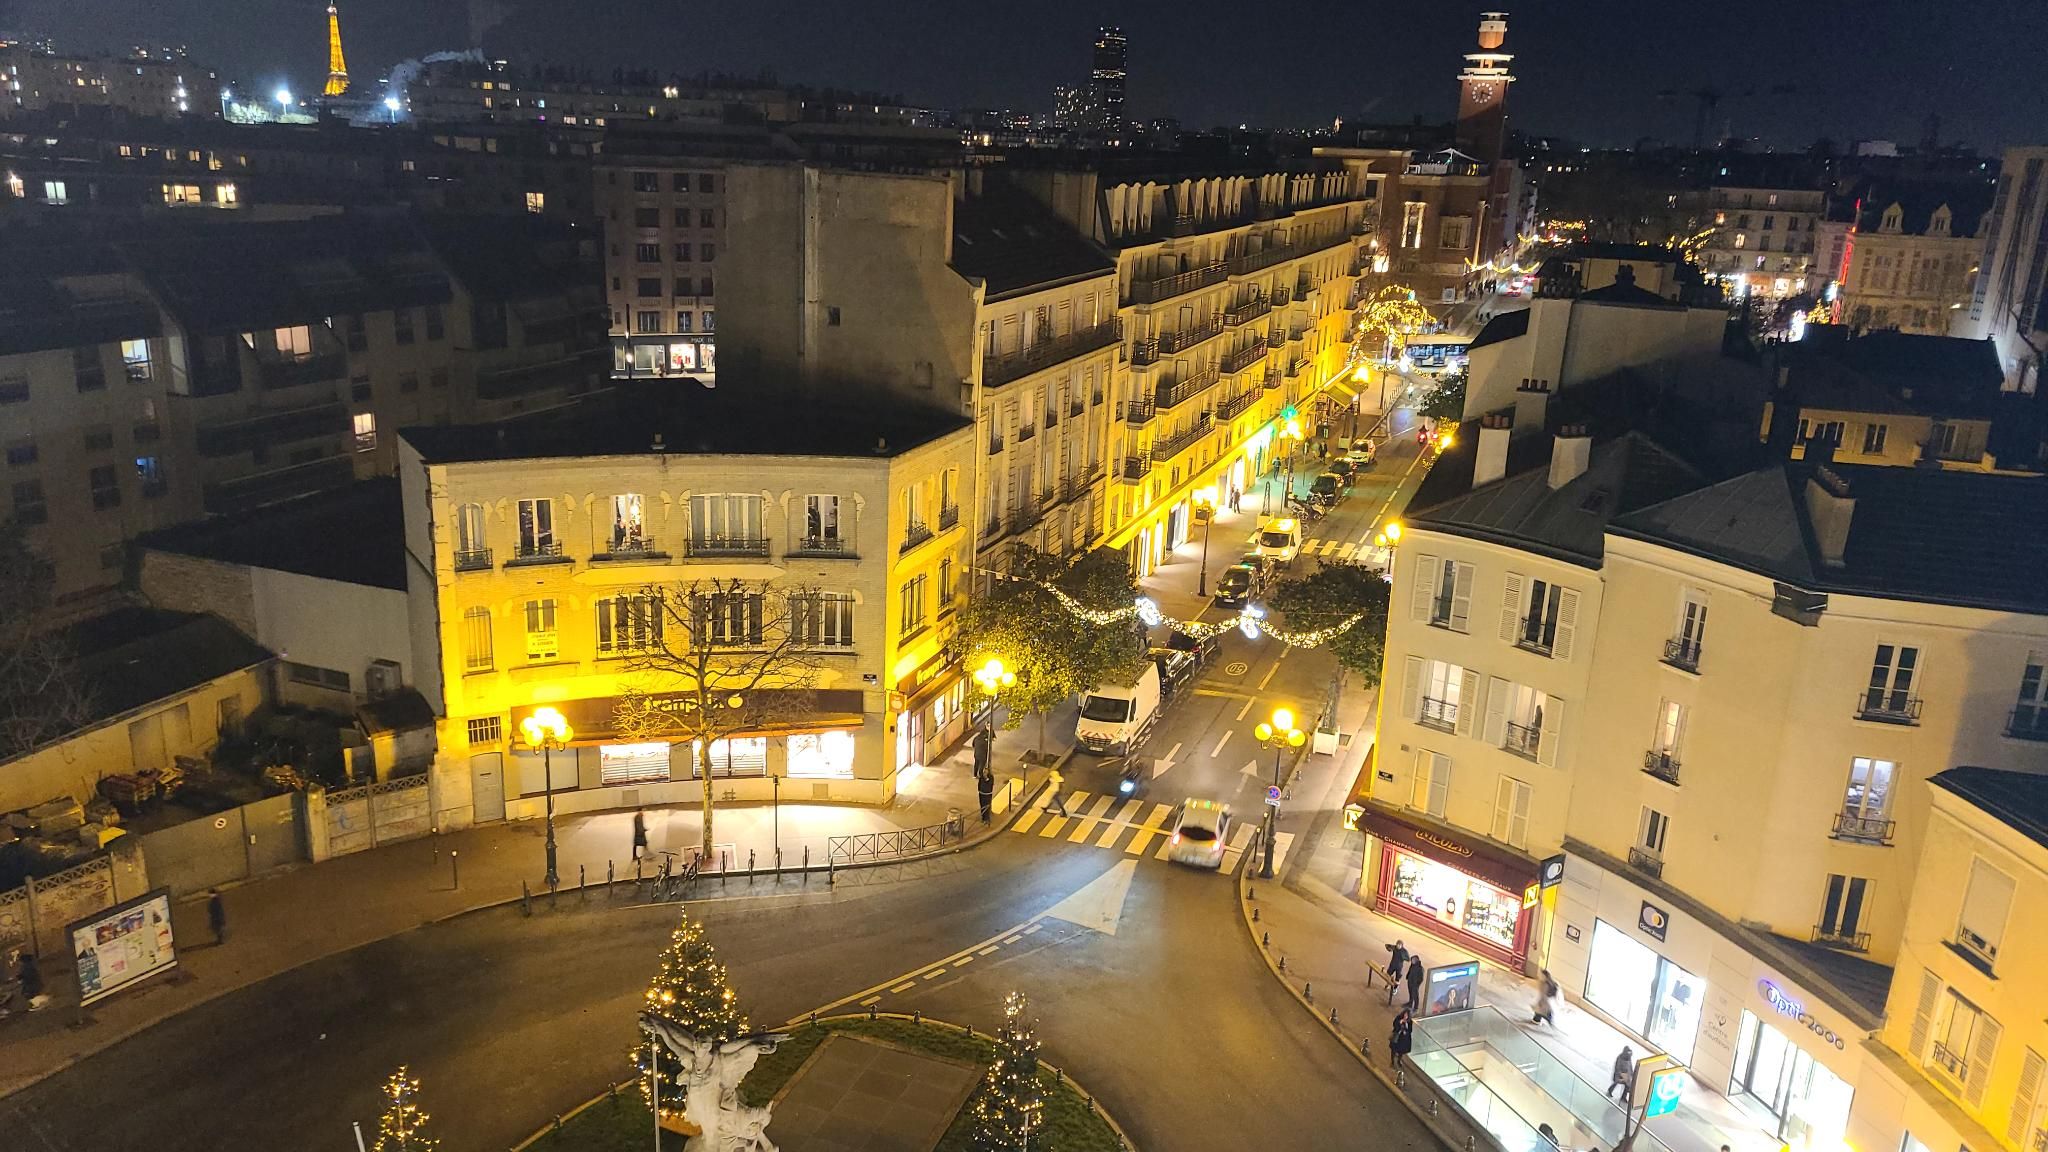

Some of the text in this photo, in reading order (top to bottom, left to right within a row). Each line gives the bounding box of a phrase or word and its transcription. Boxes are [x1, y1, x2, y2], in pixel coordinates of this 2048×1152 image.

[643, 692, 725, 713] franpix
[1418, 830, 1470, 855] NICOLAS
[1766, 984, 1844, 1050] Optic 2000
